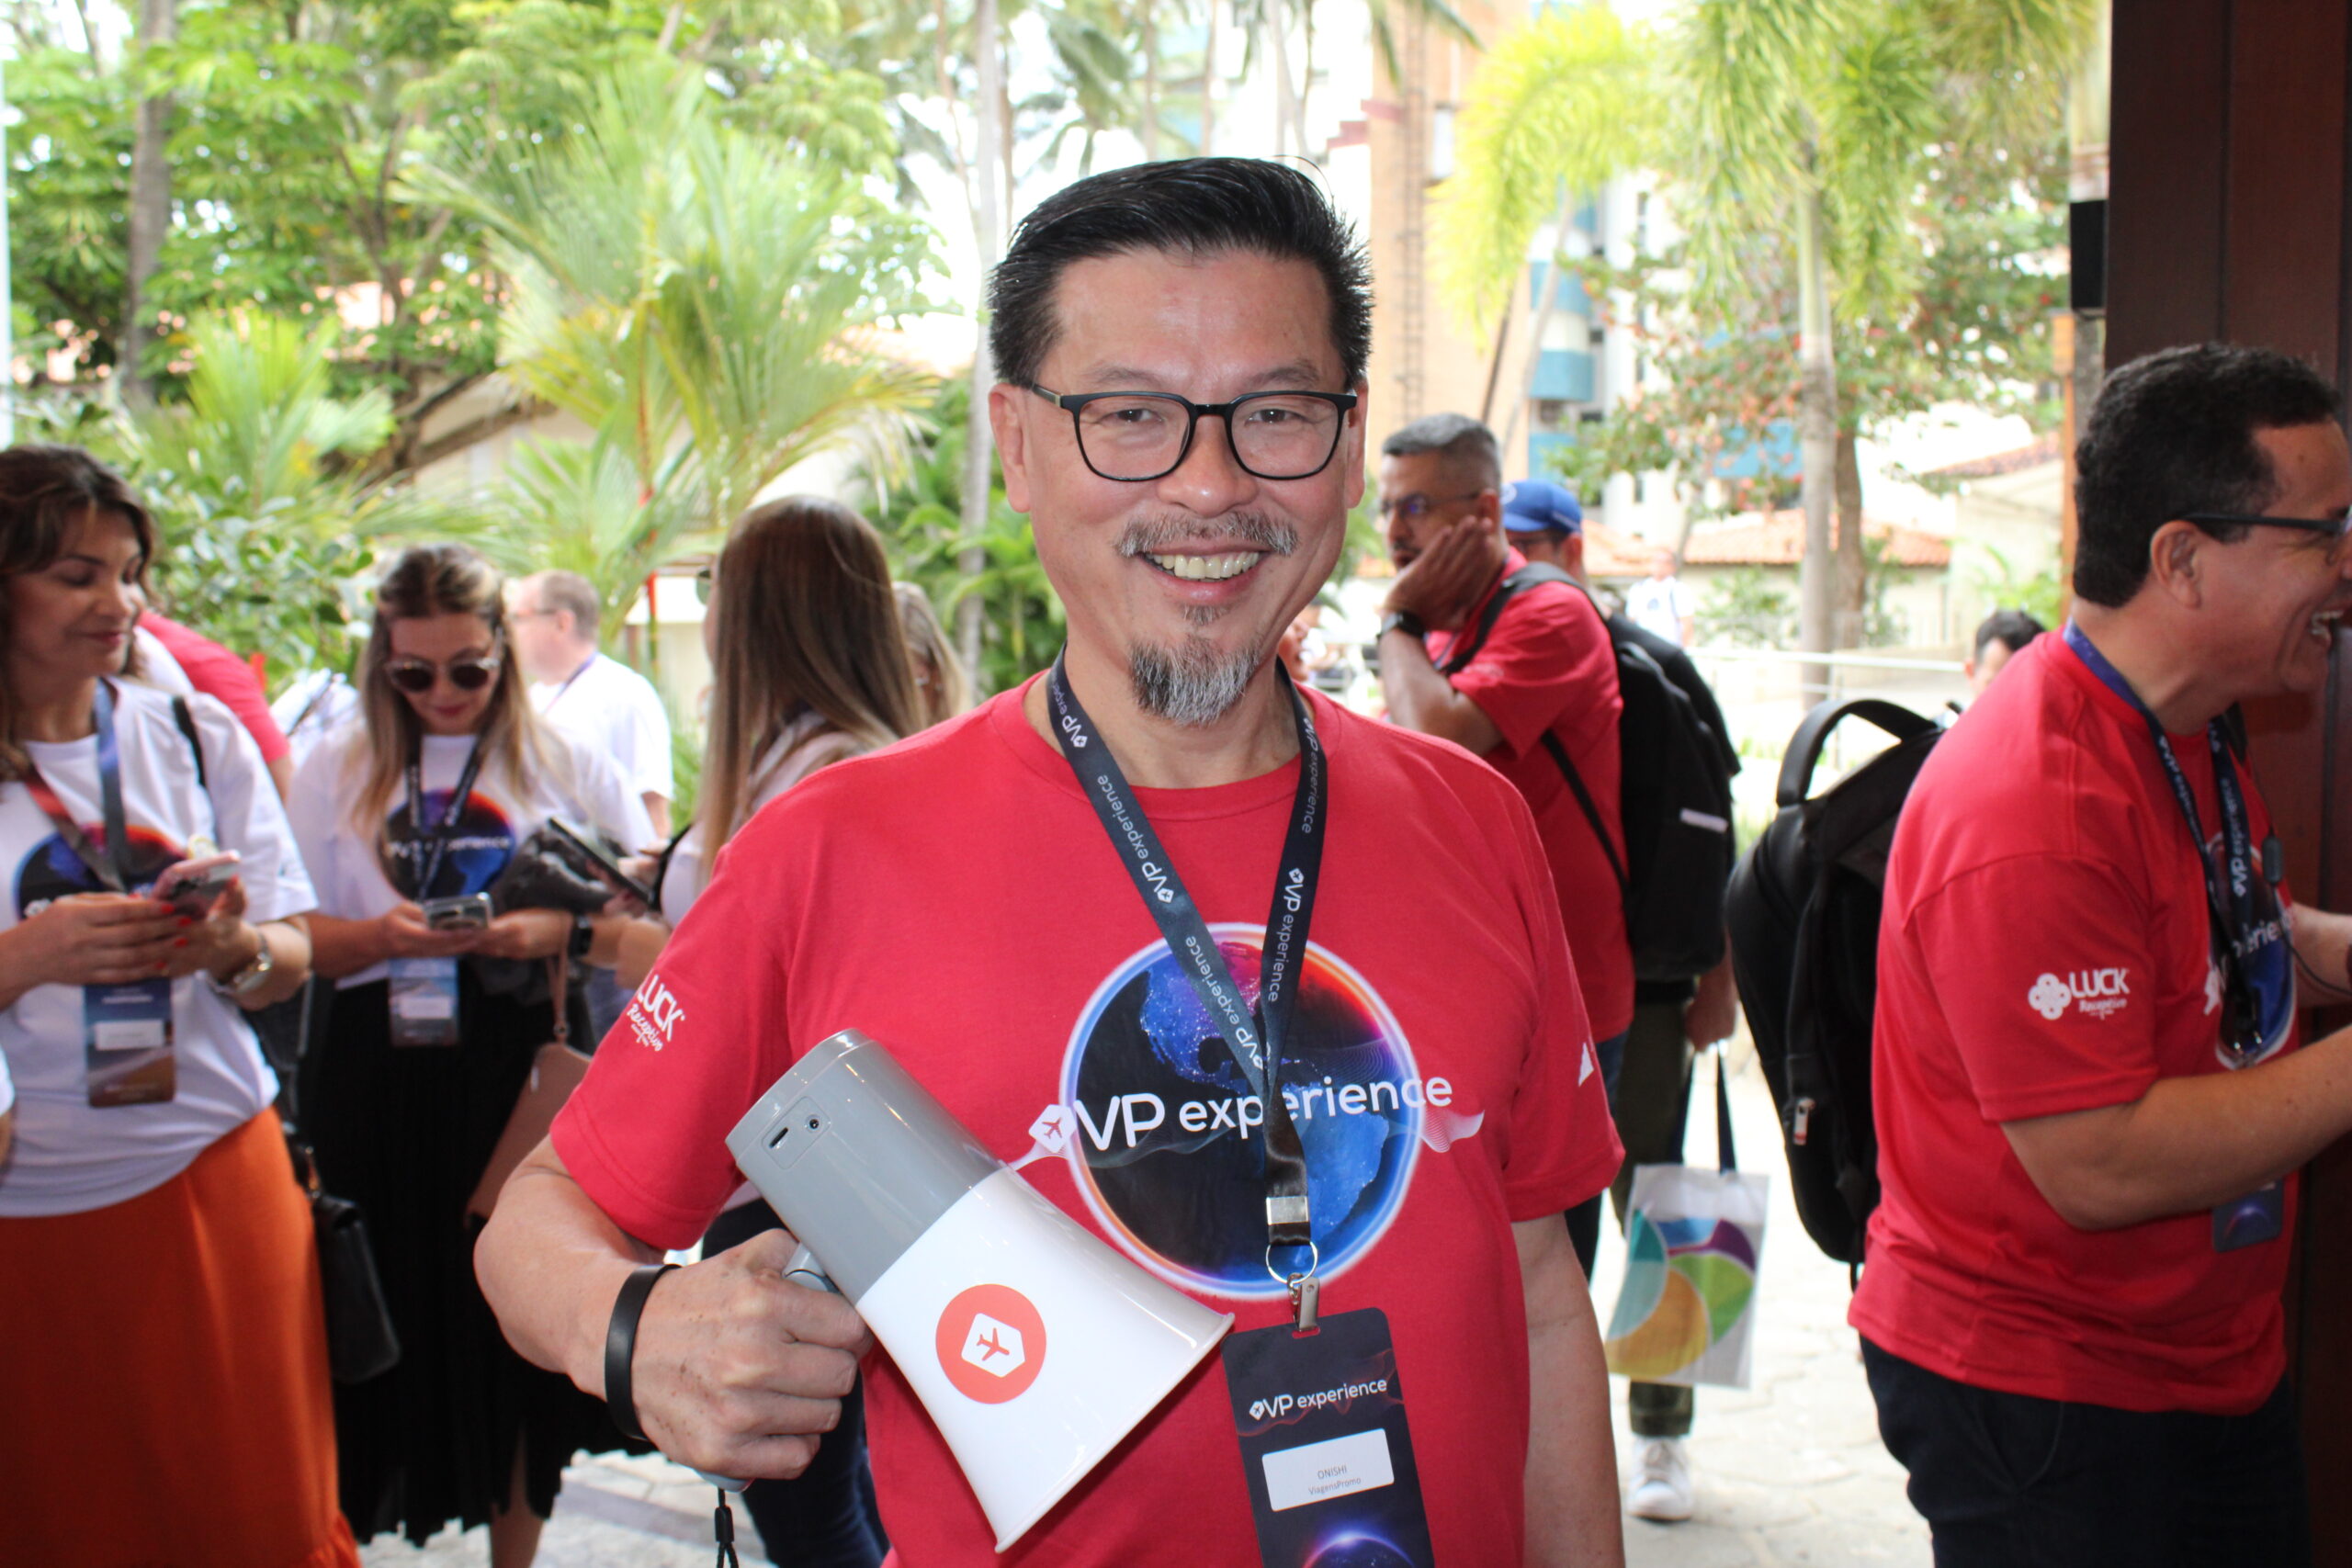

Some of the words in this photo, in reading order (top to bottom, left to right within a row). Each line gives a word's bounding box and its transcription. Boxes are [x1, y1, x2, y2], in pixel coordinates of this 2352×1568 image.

[1061, 714, 1082, 741] VP
[1304, 724, 1319, 752] VP
[1301, 750, 1320, 834] experience
[1097, 773, 1149, 861] experience
[1141, 861, 1168, 894] VP
[1283, 883, 1305, 912] VP
[1267, 914, 1295, 1003] experience
[1185, 935, 1240, 1026] experience
[2068, 967, 2131, 998] LUCK
[1235, 1026, 1259, 1060] VP
[1073, 1092, 1166, 1151] VP
[1178, 1076, 1453, 1140] experience
[1262, 1393, 1294, 1418] VP
[1296, 1379, 1387, 1410] experience
[1307, 1478, 1362, 1495] ViagensPromo
[1317, 1464, 1348, 1480] ONISHI
